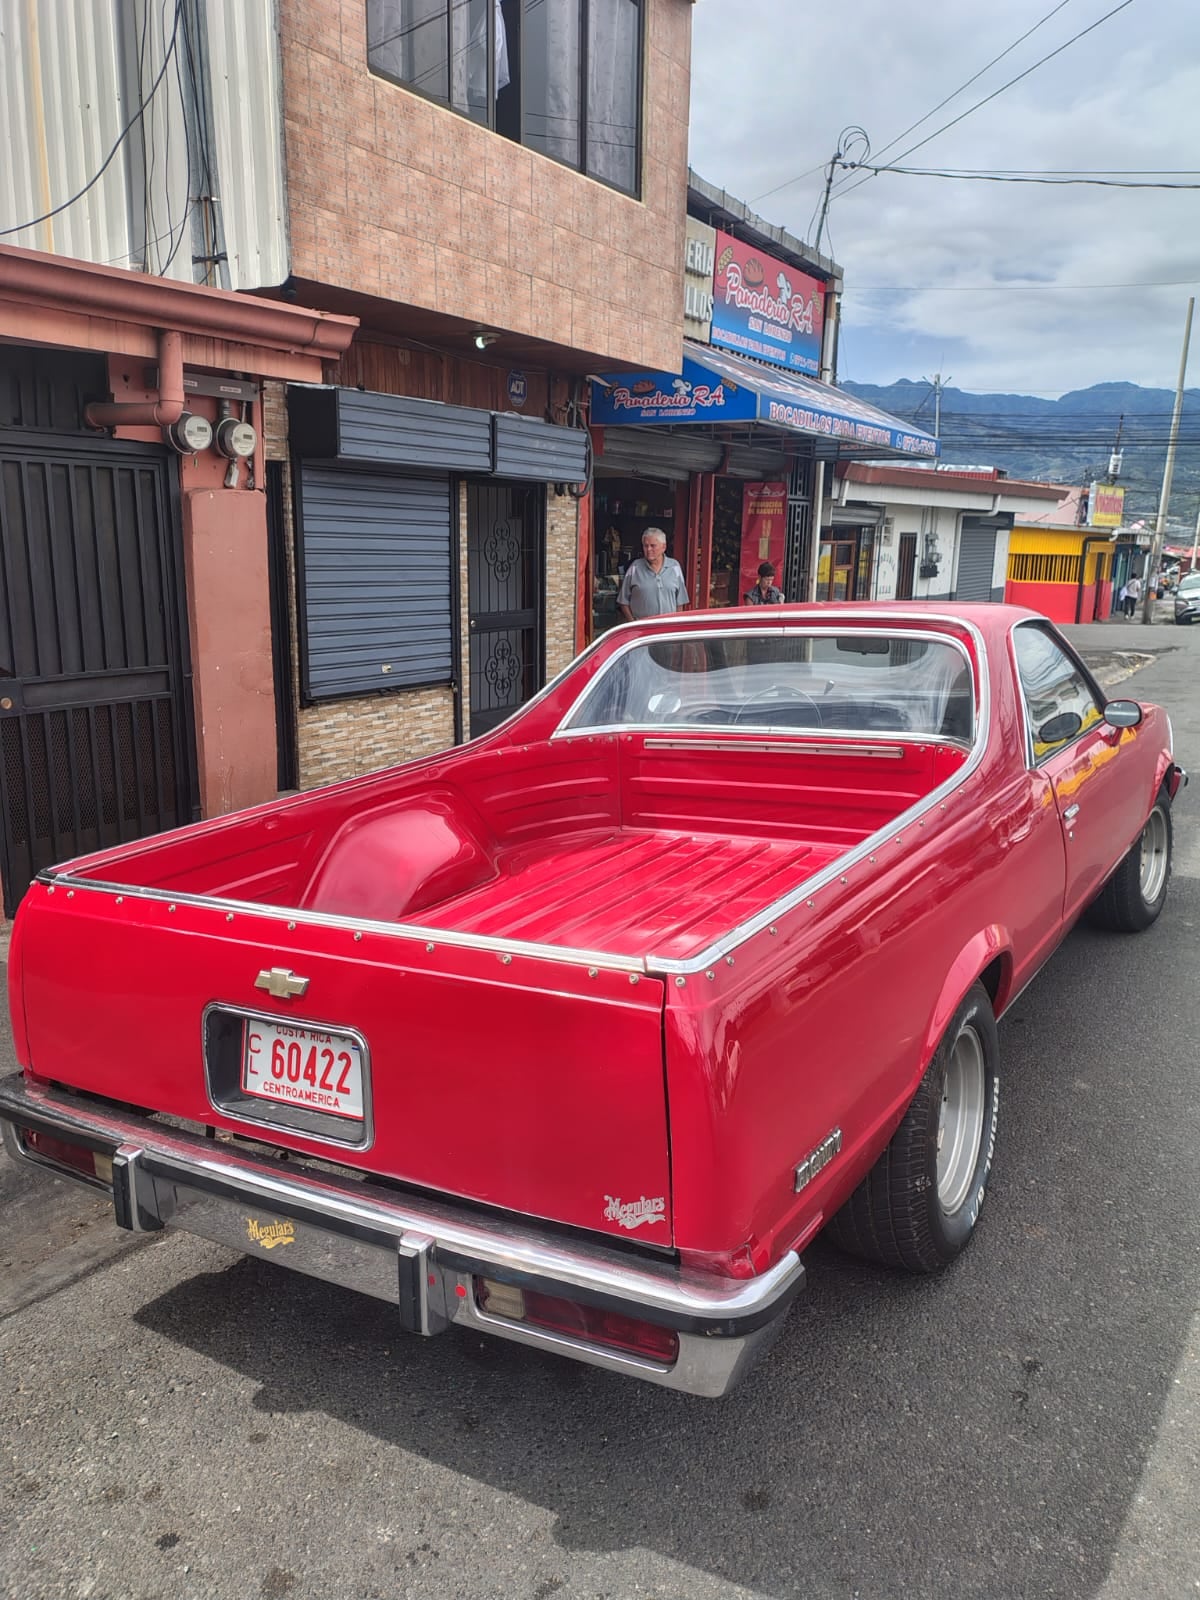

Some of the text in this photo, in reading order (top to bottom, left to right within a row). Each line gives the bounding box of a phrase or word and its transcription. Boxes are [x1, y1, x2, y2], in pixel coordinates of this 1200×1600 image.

[748, 316, 792, 343] SAN LORENZO
[510, 380, 524, 395] ADT
[769, 402, 831, 433] BOCADILLOS
[831, 417, 855, 438] PARA
[855, 423, 891, 446] EVENTOS
[276, 1025, 332, 1044] COSTA RICA
[271, 1038, 352, 1095] 60422
[263, 1081, 340, 1108] CENTROAMERICA
[983, 1077, 1000, 1173] RADIAL
